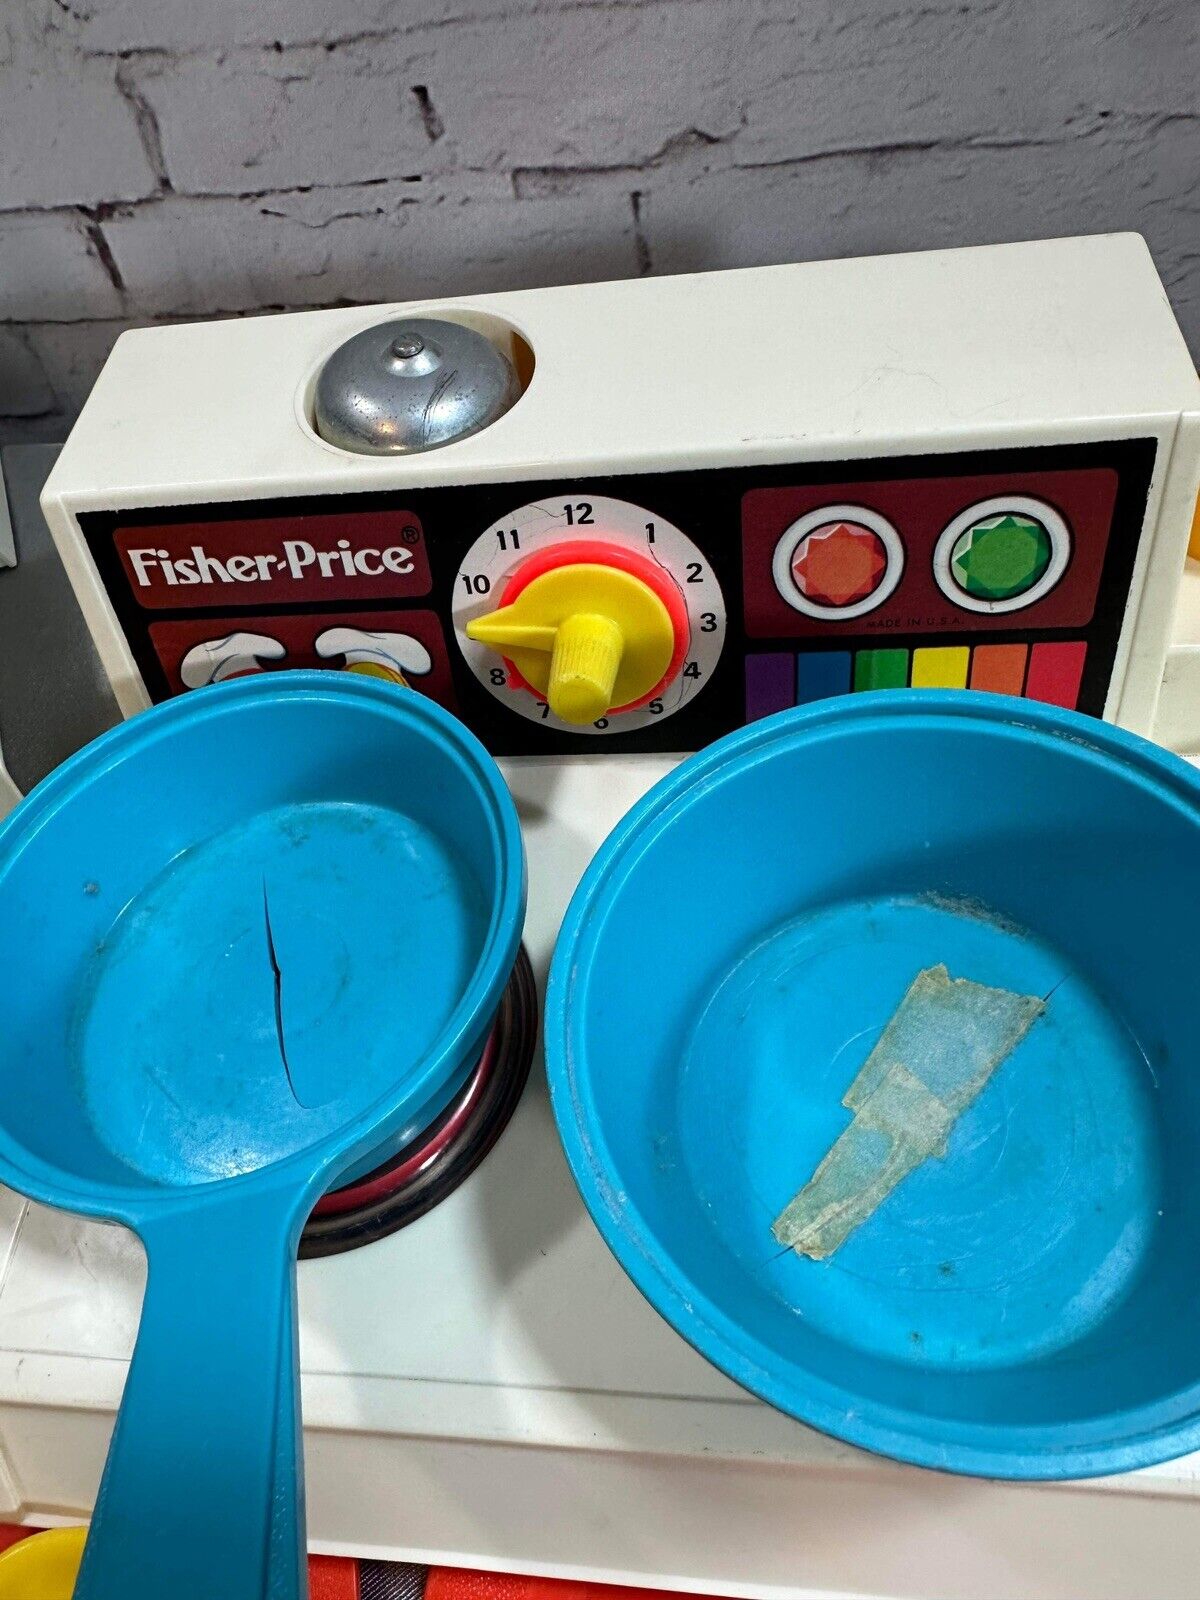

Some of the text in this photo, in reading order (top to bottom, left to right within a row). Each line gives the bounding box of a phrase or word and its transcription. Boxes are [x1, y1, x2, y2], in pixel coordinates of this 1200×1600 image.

[563, 503, 595, 525] 12
[496, 529, 520, 551] 11
[645, 522, 656, 544] 1
[686, 562, 704, 583] 2
[462, 574, 491, 595] 10
[700, 613, 718, 633] 3
[866, 618, 901, 628] MADE
[907, 617, 921, 626] IN
[490, 668, 506, 686] 8
[683, 661, 702, 680] 4
[536, 702, 550, 719] 7
[649, 697, 664, 715] 5
[593, 714, 609, 730] 6
